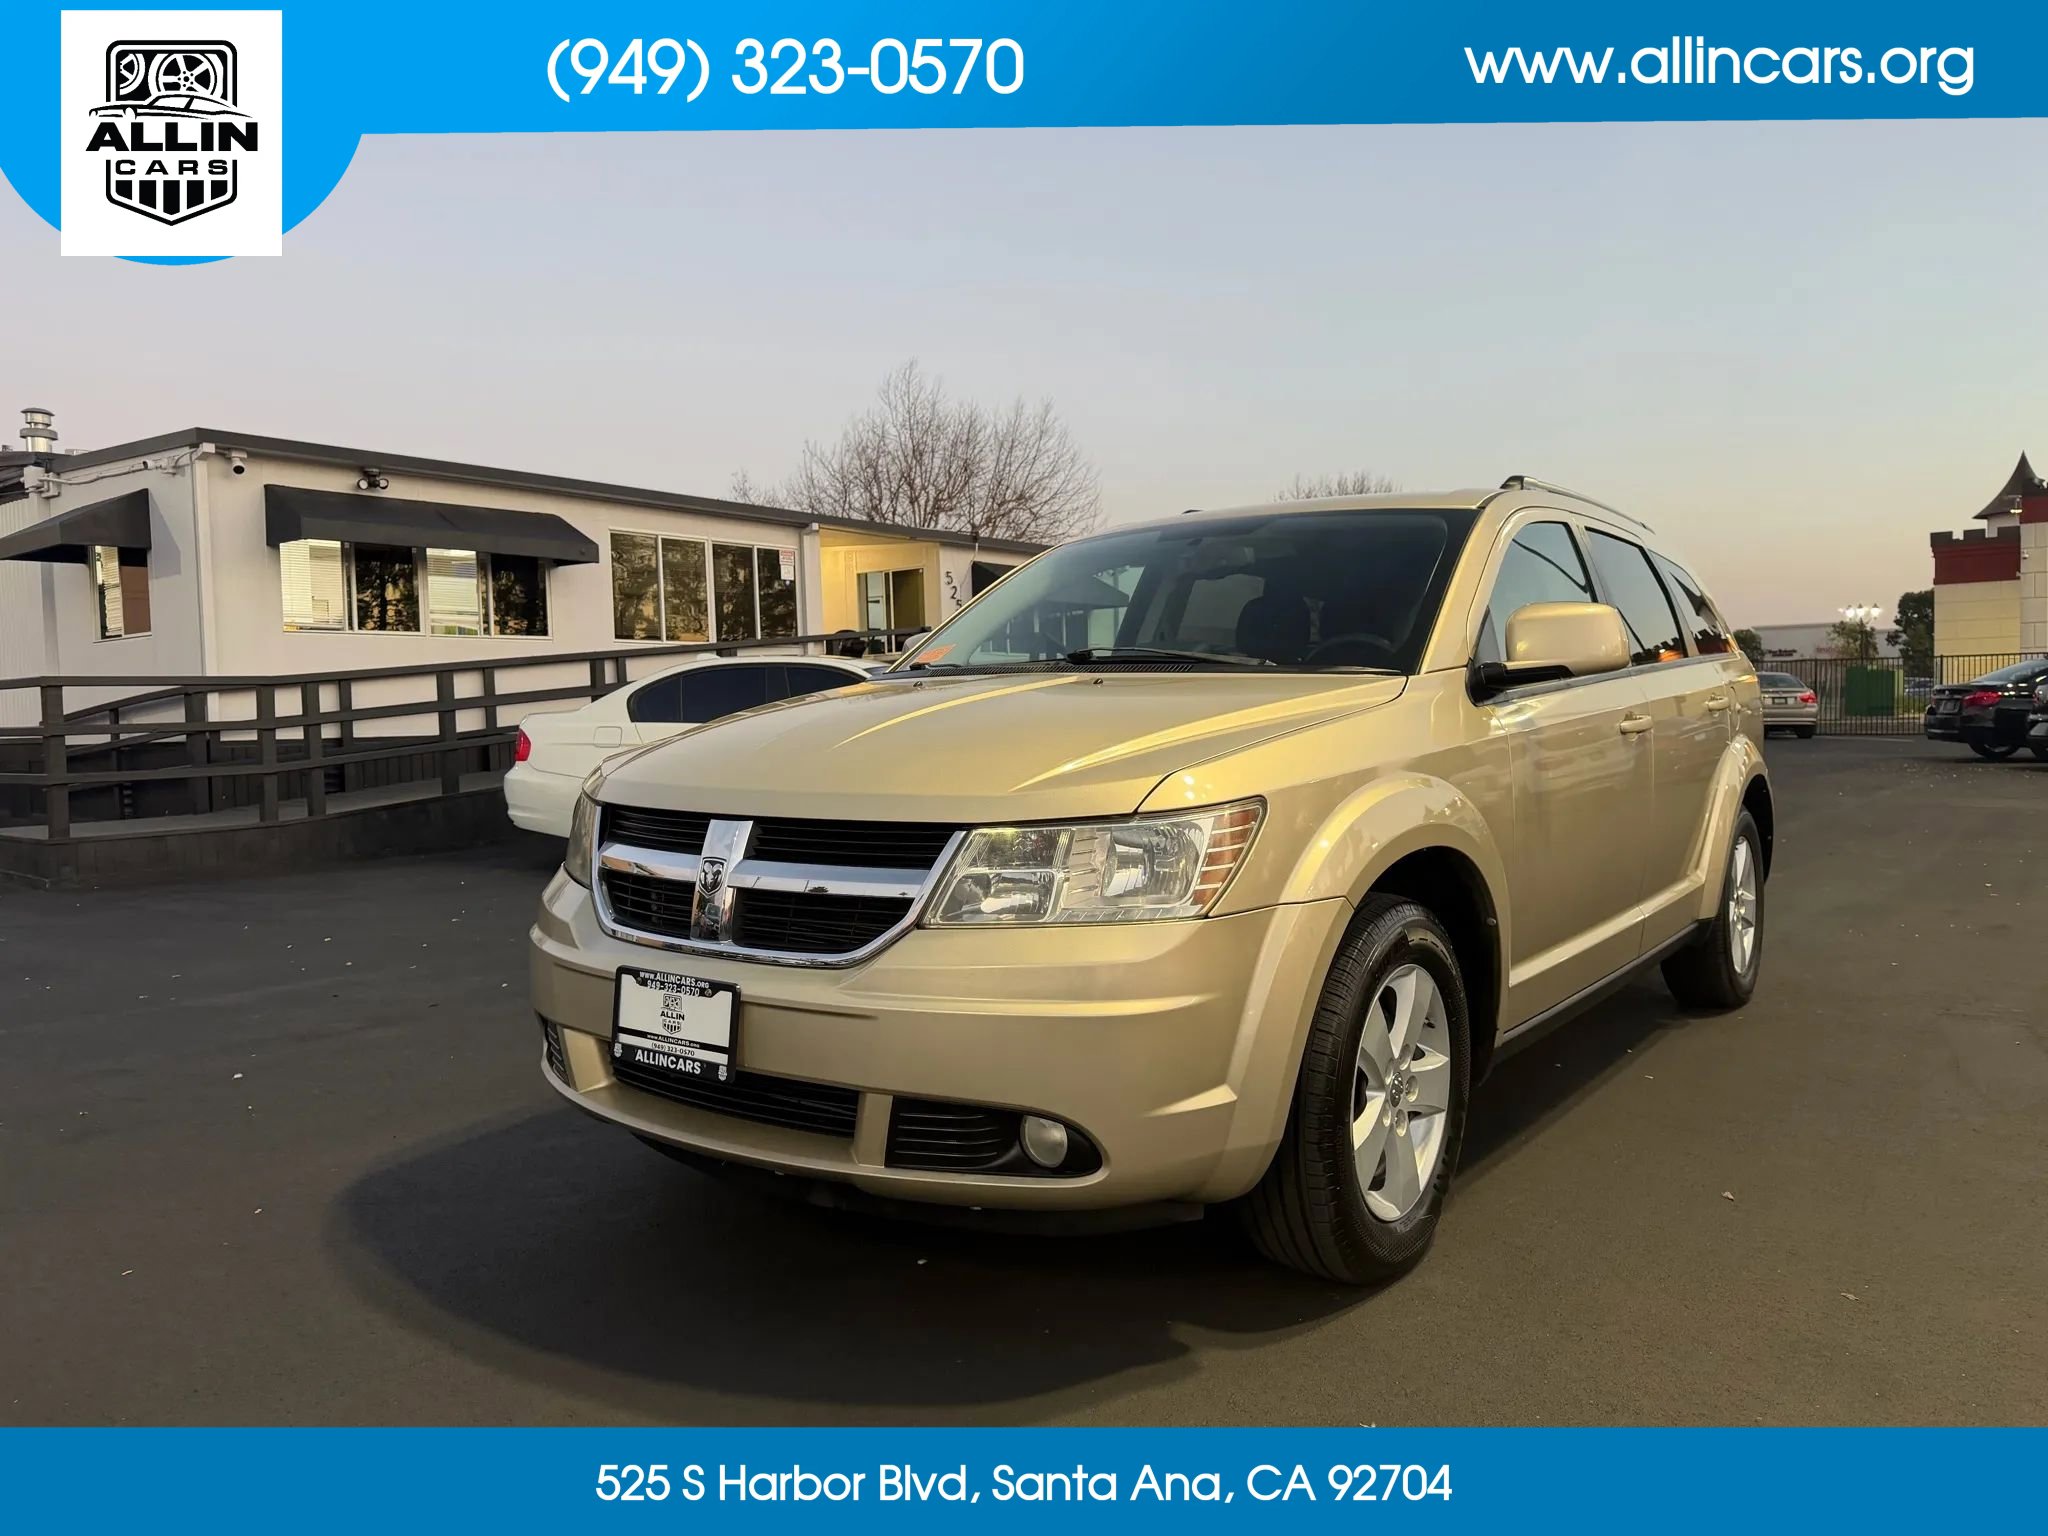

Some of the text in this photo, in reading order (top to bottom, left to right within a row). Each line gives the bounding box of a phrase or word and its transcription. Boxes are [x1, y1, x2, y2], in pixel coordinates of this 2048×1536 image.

[647, 980, 700, 997] 949-323-0570
[660, 1010, 685, 1021] ALLIN
[651, 1042, 695, 1057] (949) 323-0570
[635, 1049, 702, 1075] ALLINCARS
